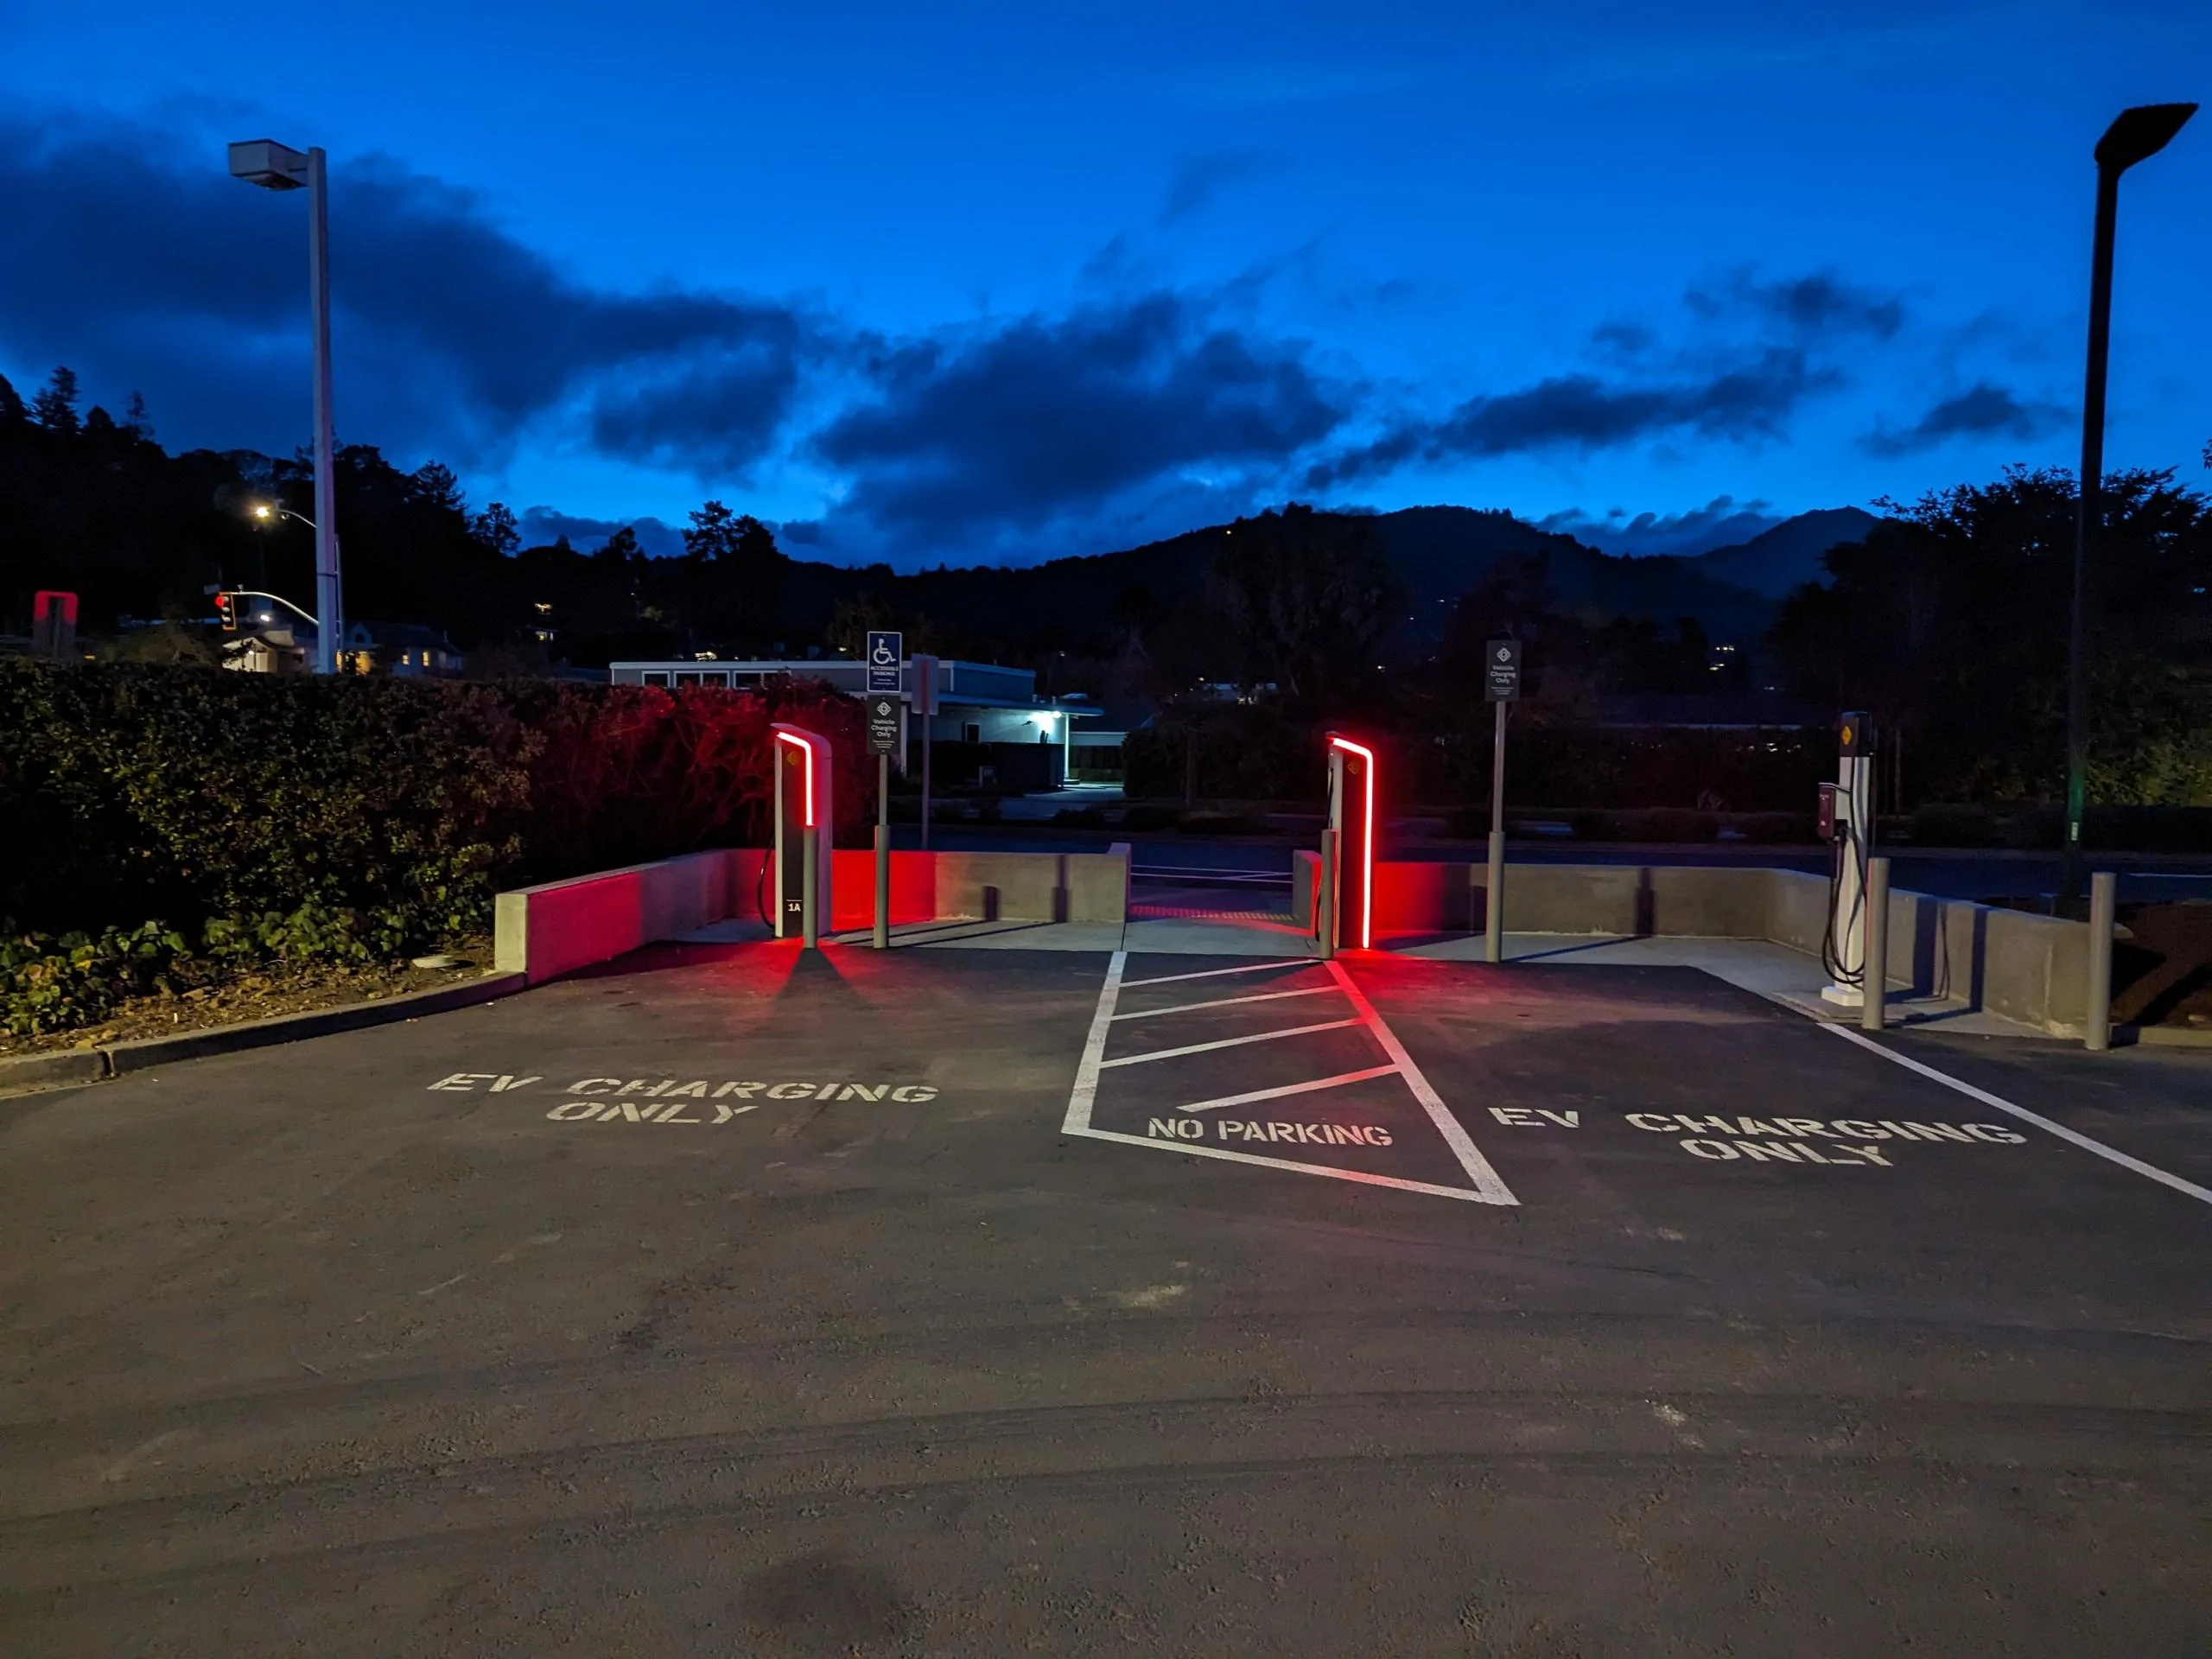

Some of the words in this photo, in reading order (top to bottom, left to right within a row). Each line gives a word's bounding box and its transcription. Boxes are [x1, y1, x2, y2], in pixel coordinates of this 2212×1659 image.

[787, 903, 801, 912] 1A
[427, 1073, 543, 1092] EV
[566, 1078, 939, 1103] CHARGING
[546, 1102, 760, 1124] ONLY
[1487, 1107, 1580, 1128] EV
[1624, 1113, 2028, 1145] CHARGING
[1147, 1117, 1204, 1139] NO
[1218, 1120, 1393, 1147] PARKING
[1679, 1139, 1894, 1166] ONLY
